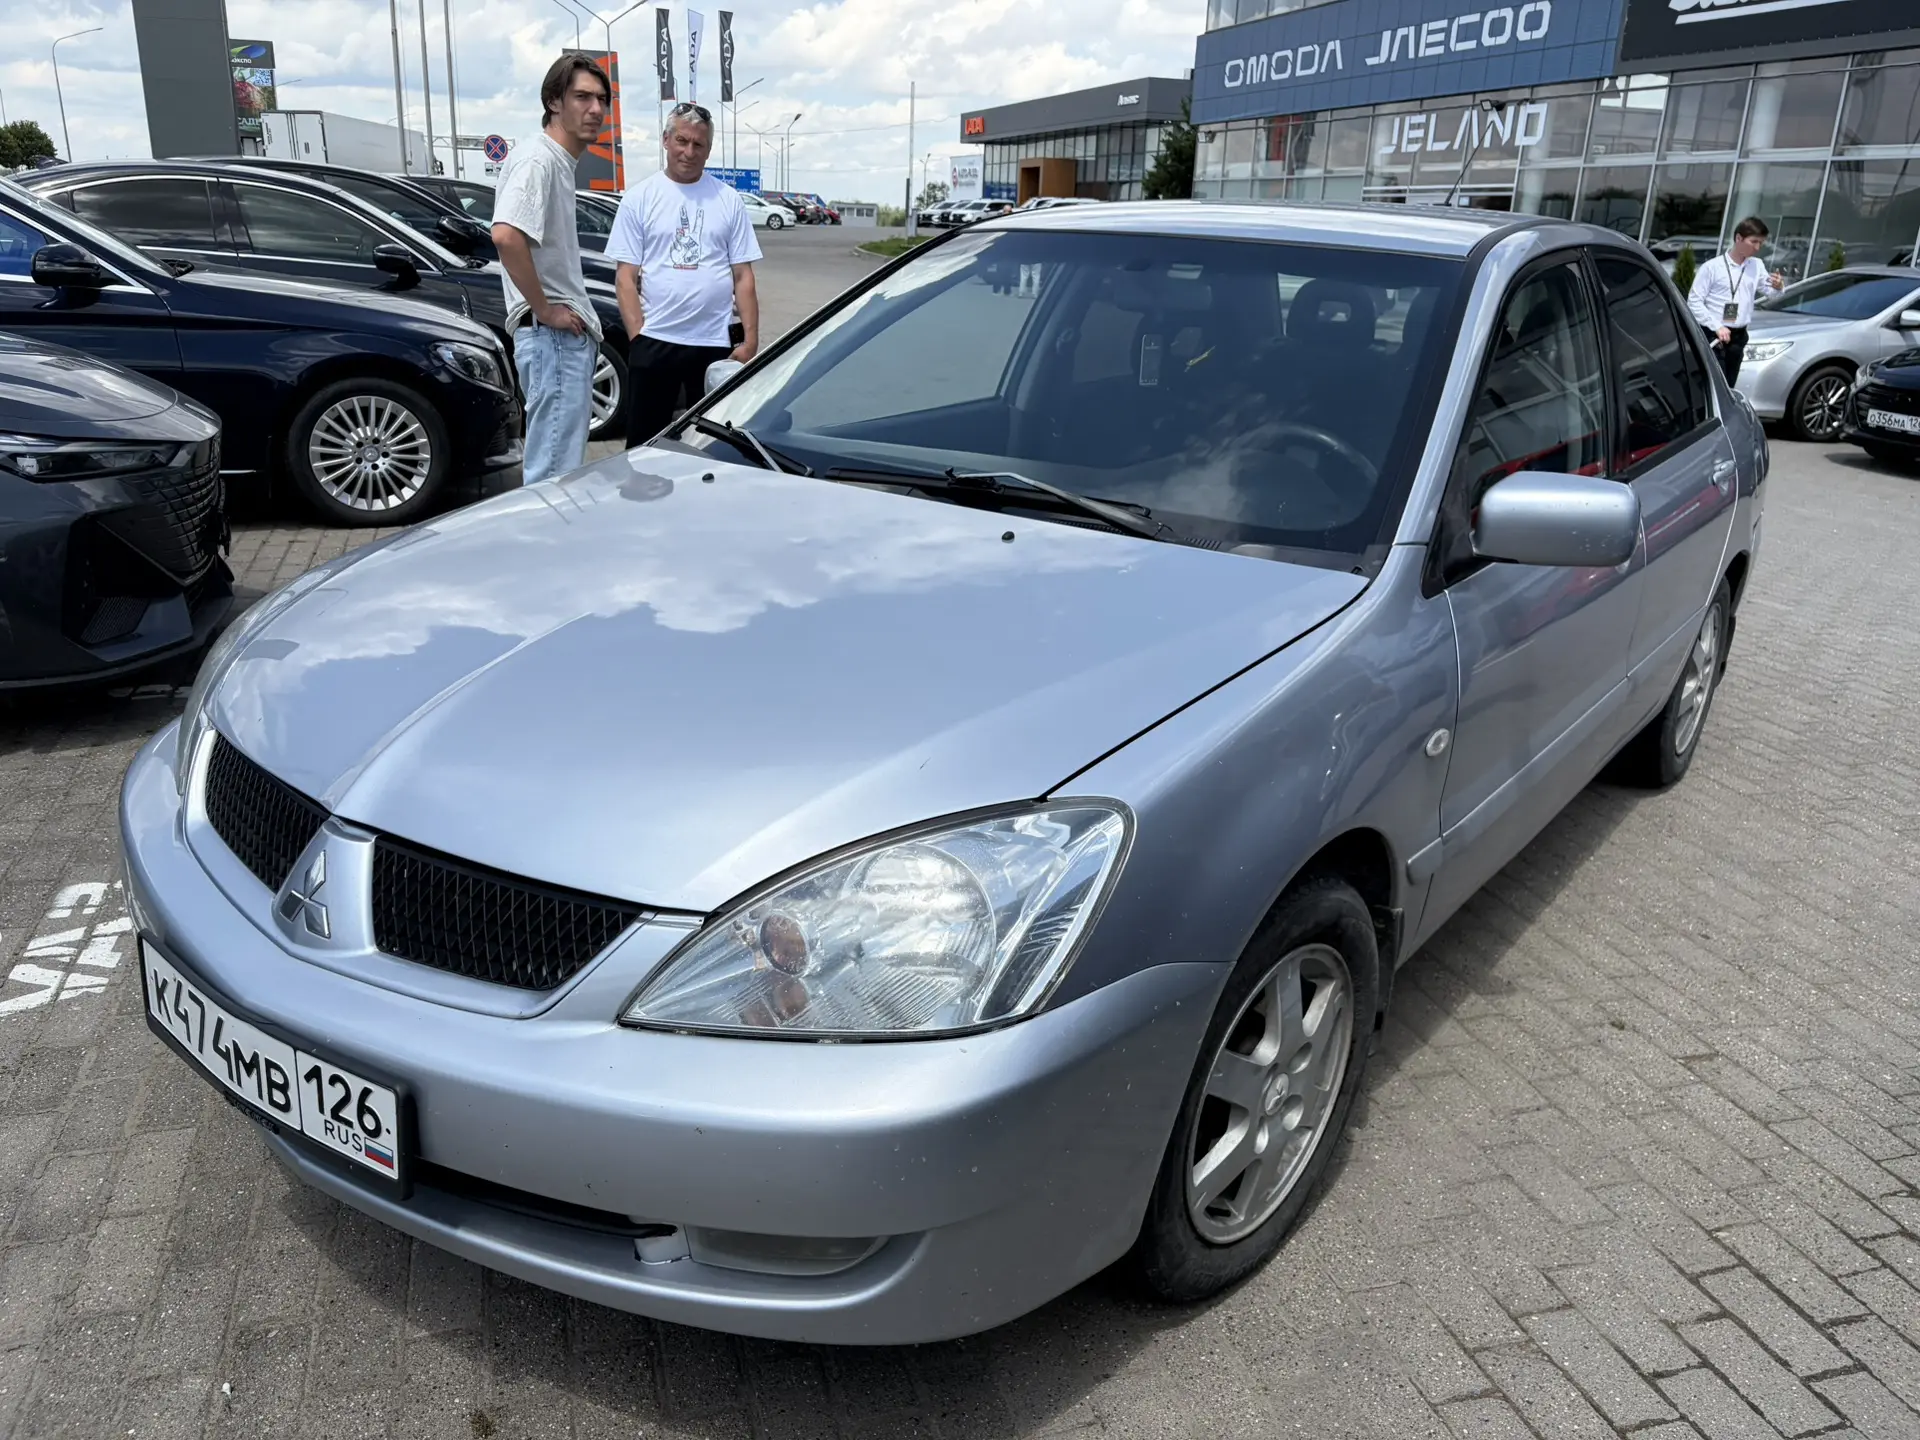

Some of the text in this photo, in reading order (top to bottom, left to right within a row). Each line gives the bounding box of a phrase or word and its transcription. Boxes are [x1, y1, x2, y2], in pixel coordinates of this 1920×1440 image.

[661, 27, 669, 82] LADA
[1223, 0, 1552, 88] OMODA JAECOO
[1380, 102, 1549, 154] JELAND
[303, 1064, 383, 1139] 126
[324, 1119, 364, 1153] RUS
